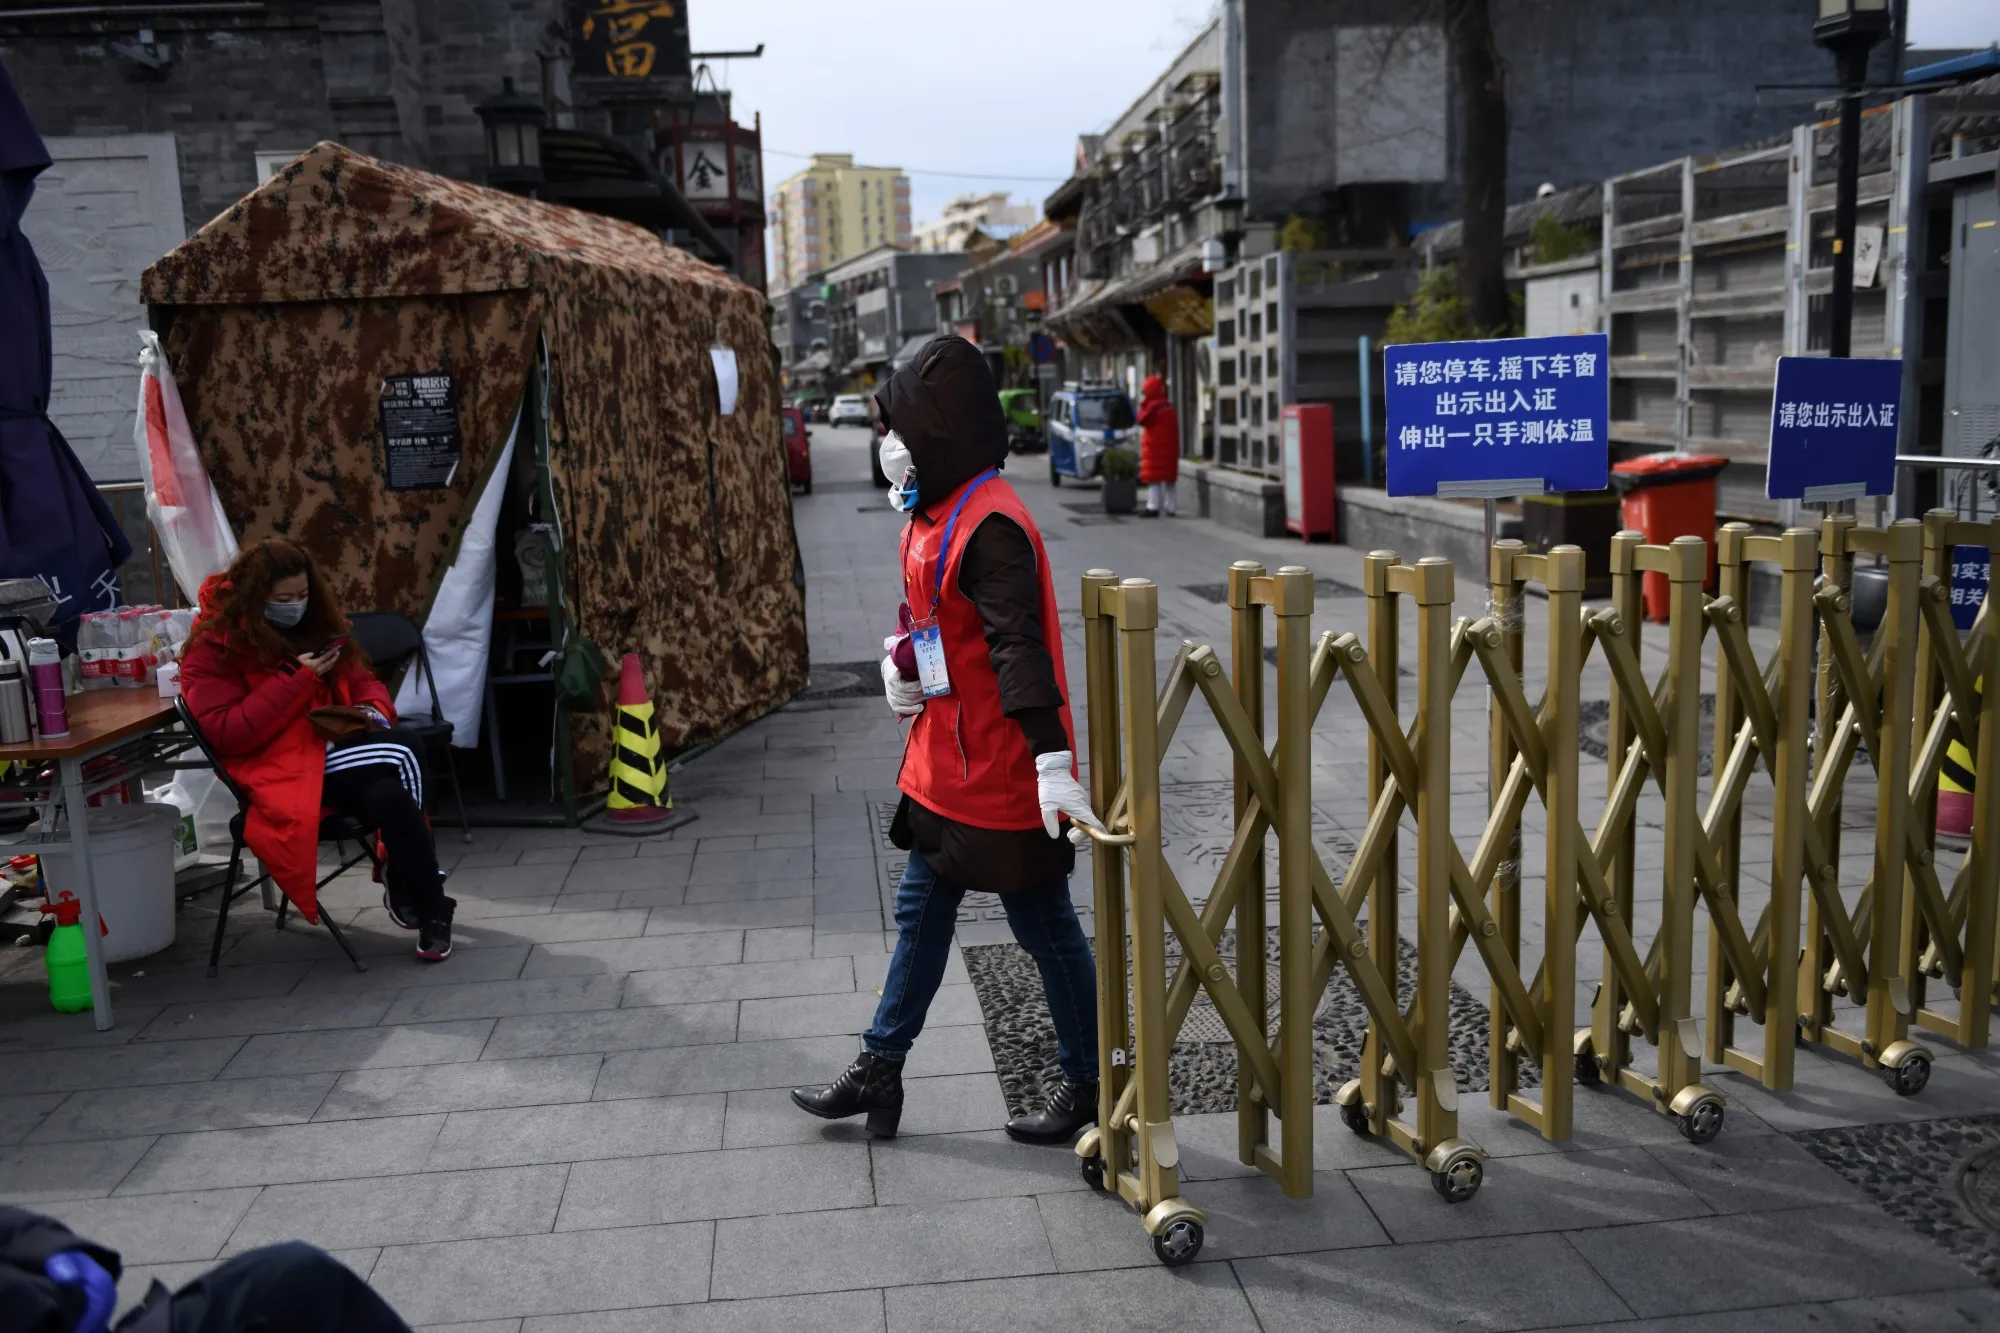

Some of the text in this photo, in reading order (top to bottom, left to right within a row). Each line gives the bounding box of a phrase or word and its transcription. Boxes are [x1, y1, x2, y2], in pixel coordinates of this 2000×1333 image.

[1395, 352, 1597, 386] 请您停车,摇下车窗
[1436, 388, 1557, 416] 出示出入证
[1779, 402, 1895, 429] 请您出示出入证
[1399, 419, 1594, 450] 伸出一只手测体温
